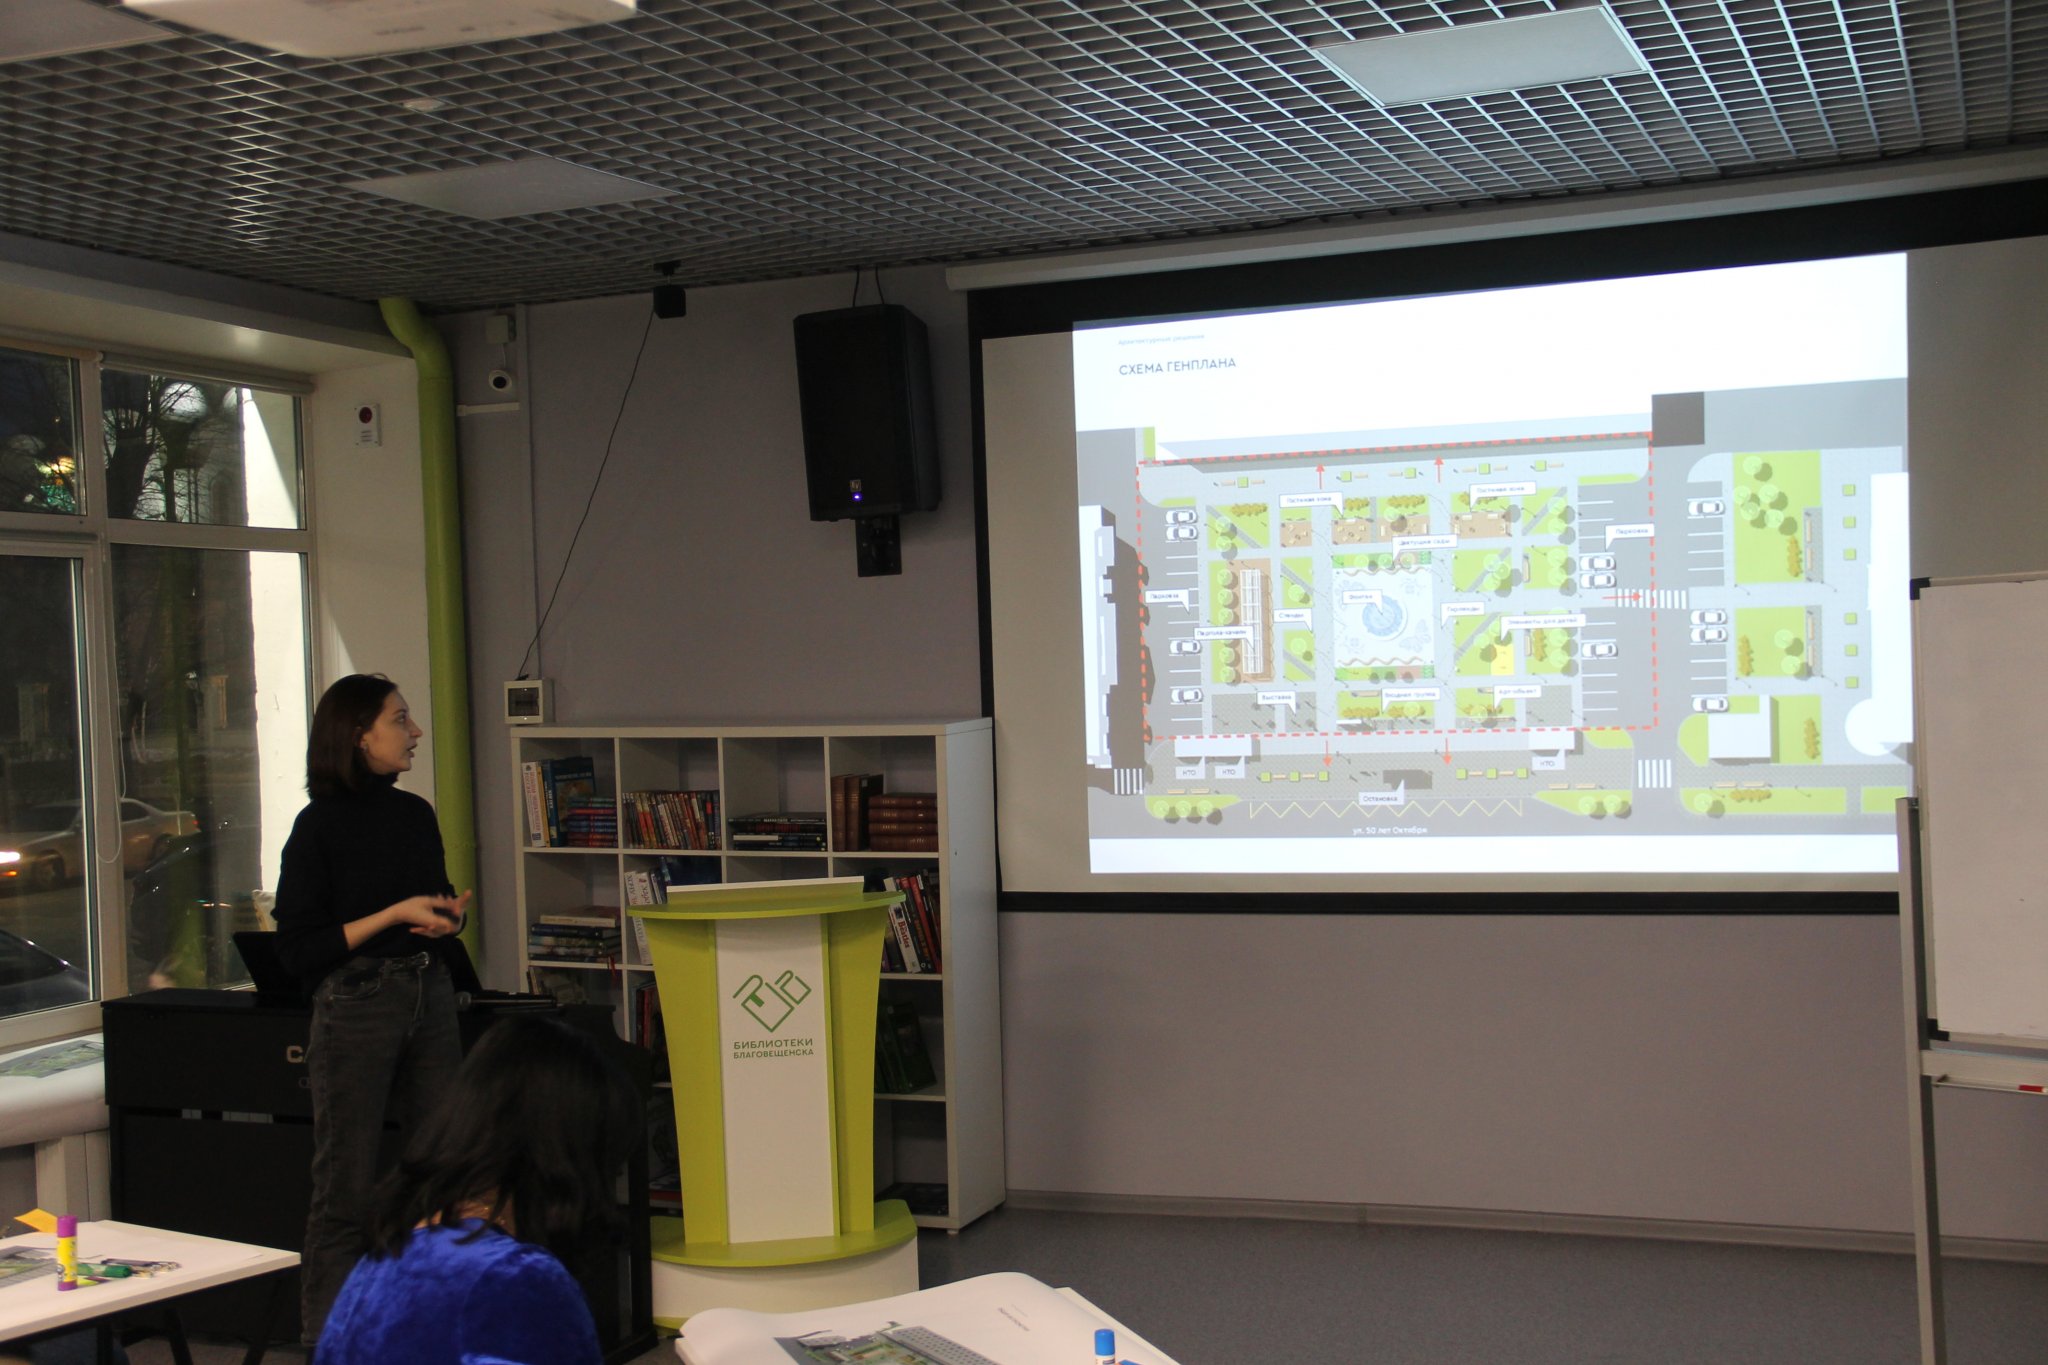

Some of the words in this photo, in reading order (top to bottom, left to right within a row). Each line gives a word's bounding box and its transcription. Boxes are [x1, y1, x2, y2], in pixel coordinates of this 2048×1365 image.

[1119, 363, 1163, 376] СХЕМА
[1167, 357, 1237, 372] ГЕНПЛАНА
[1363, 795, 1398, 803] Остановка
[1352, 827, 1365, 836] ул.
[1366, 826, 1376, 834] 50
[1377, 826, 1391, 834] лет
[1392, 825, 1428, 836] Октября
[733, 1038, 814, 1050] БИБЛИОТЕКИ
[733, 1048, 815, 1060] БЛАГОВЕЩЕНСКА
